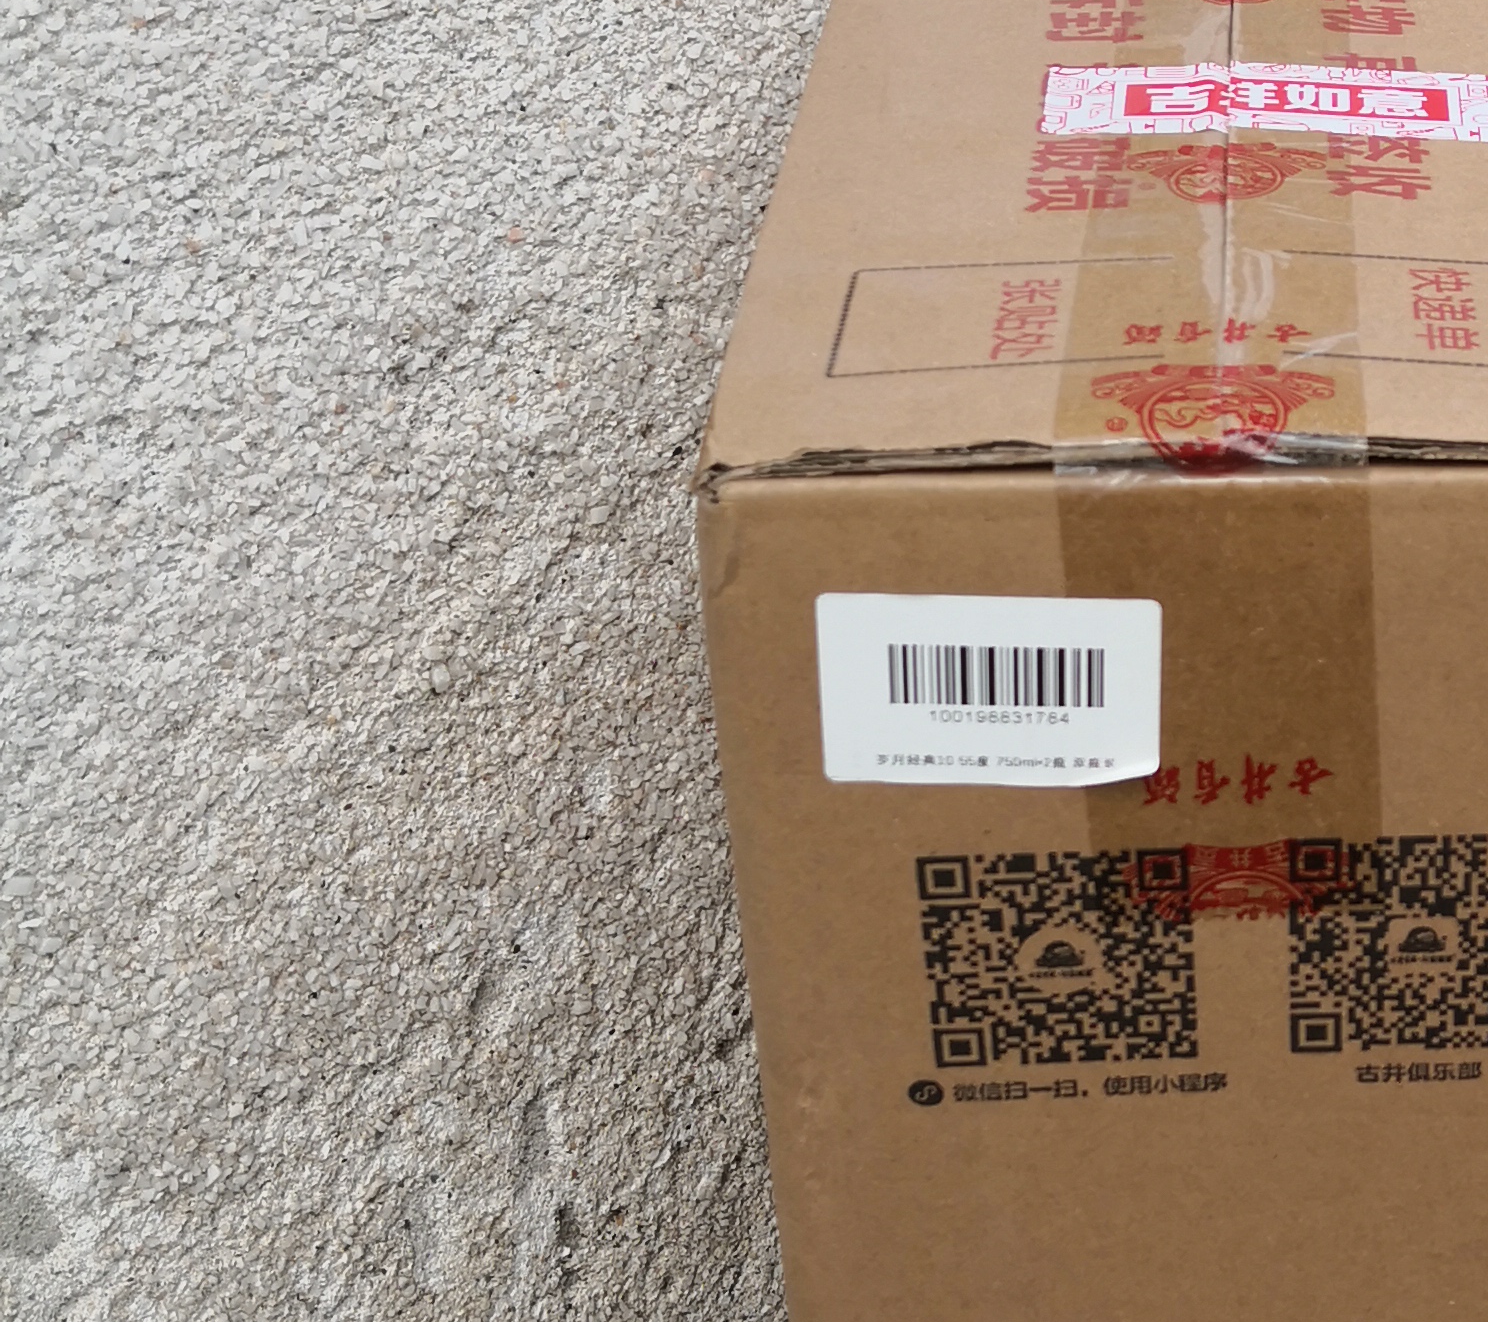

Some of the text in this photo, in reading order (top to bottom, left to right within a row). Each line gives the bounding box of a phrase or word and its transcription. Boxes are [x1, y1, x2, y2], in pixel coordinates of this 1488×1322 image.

[989, 279, 1062, 361] 张贴处
[1408, 267, 1481, 351] 快递单
[929, 709, 1070, 725] 100198831784
[1355, 1061, 1483, 1084] 古井俱乐部
